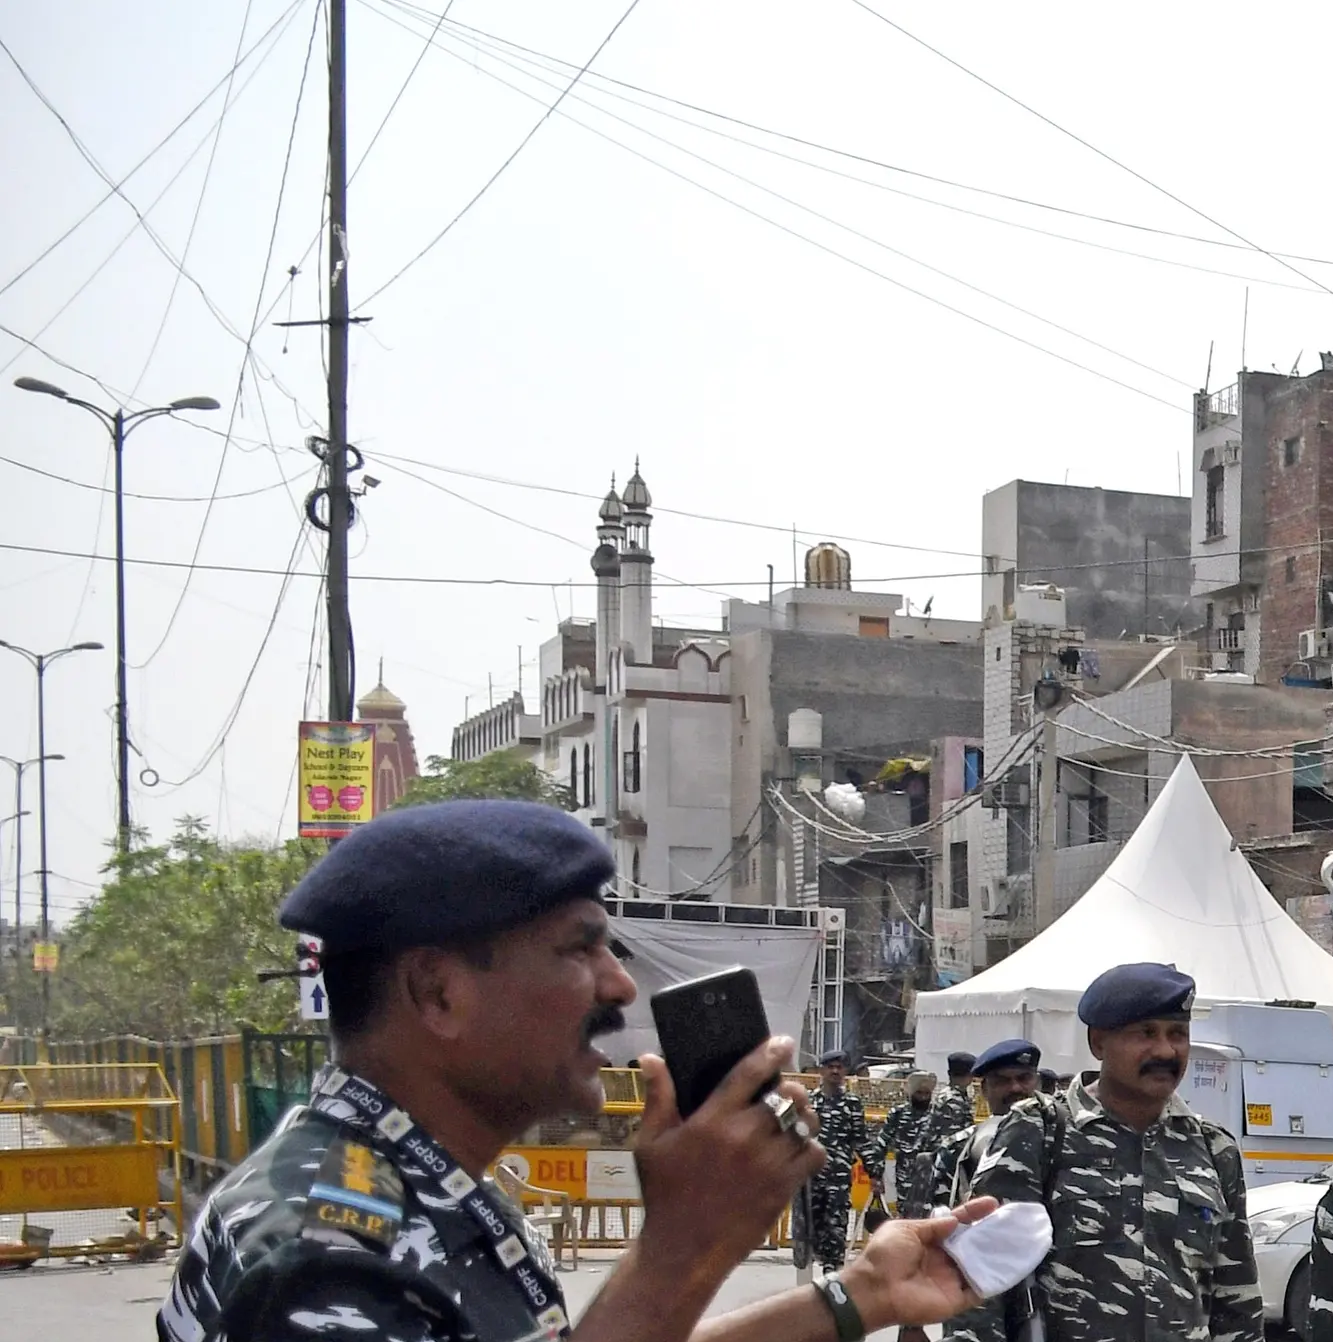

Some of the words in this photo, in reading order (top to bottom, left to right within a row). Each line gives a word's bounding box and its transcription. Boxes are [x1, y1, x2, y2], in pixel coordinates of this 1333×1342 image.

[306, 747, 335, 760] Nest
[339, 747, 366, 762] Play
[341, 1084, 383, 1114] CRPF
[405, 1137, 447, 1174] CRPF
[22, 1166, 100, 1190] POLICE
[469, 1197, 506, 1237] CRPF
[517, 1267, 547, 1307] CRPF
